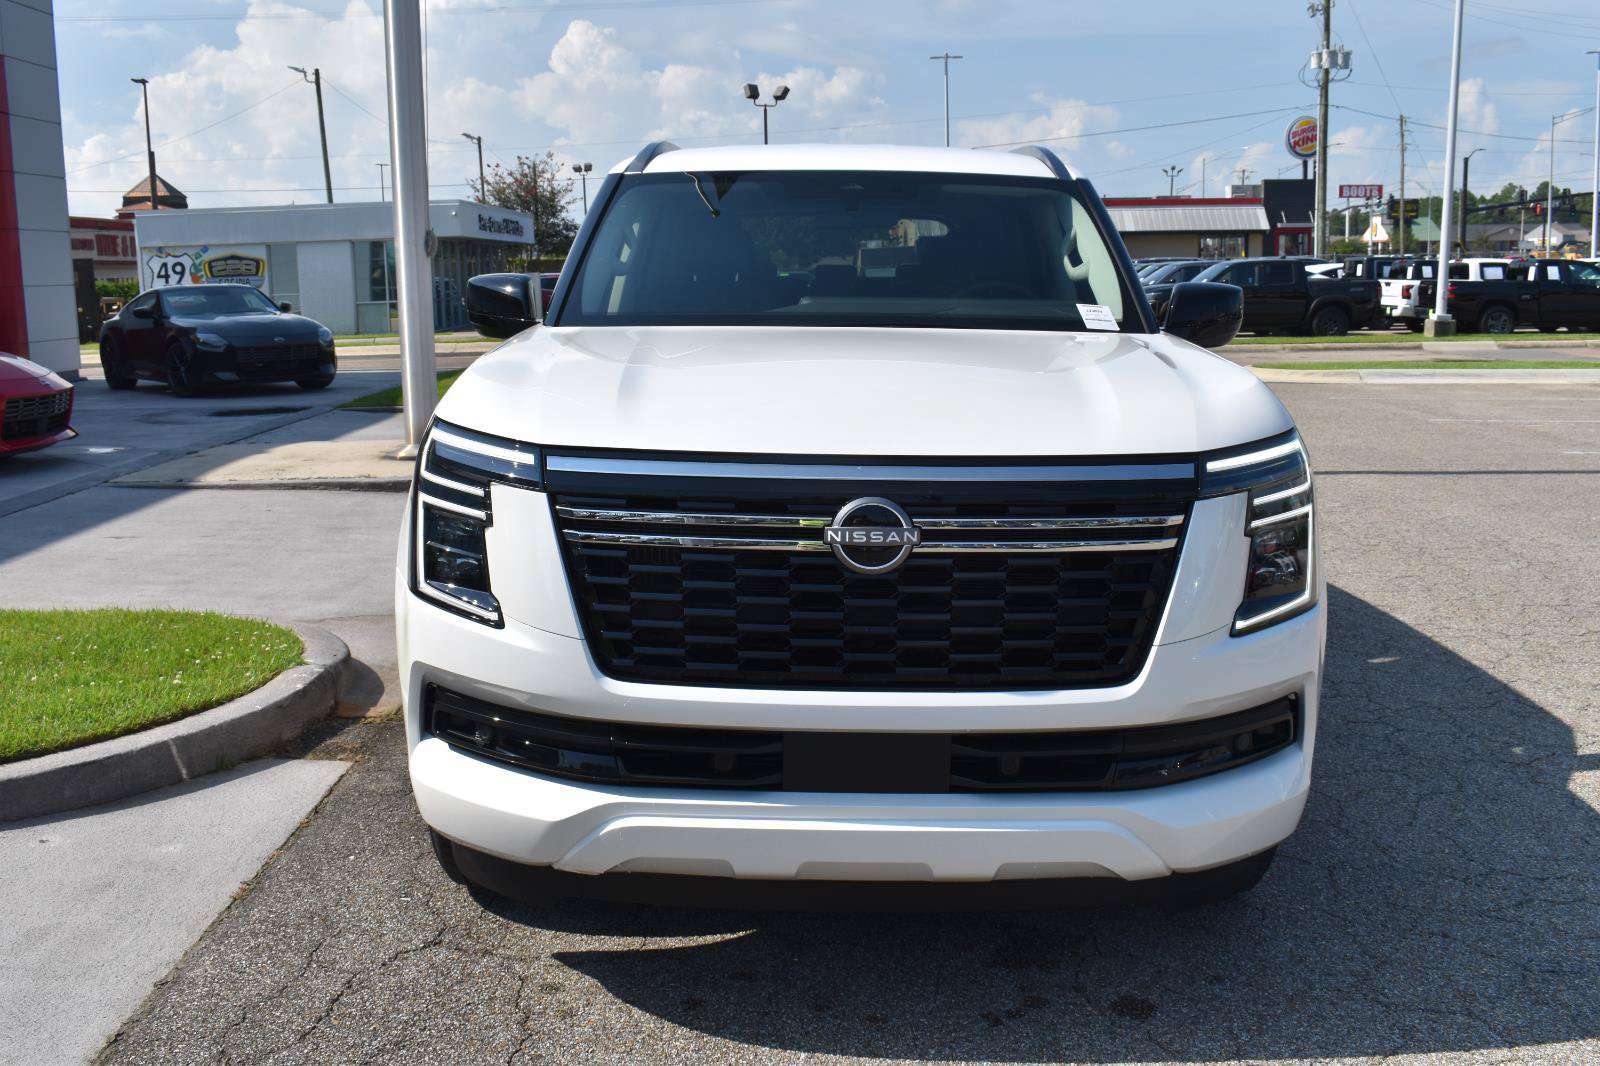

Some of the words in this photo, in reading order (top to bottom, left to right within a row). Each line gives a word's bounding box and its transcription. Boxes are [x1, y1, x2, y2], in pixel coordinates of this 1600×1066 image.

[1291, 125, 1318, 140] BURGE
[1343, 186, 1378, 197] BOOTS
[156, 261, 186, 285] 49
[827, 530, 918, 543] NISSAN
